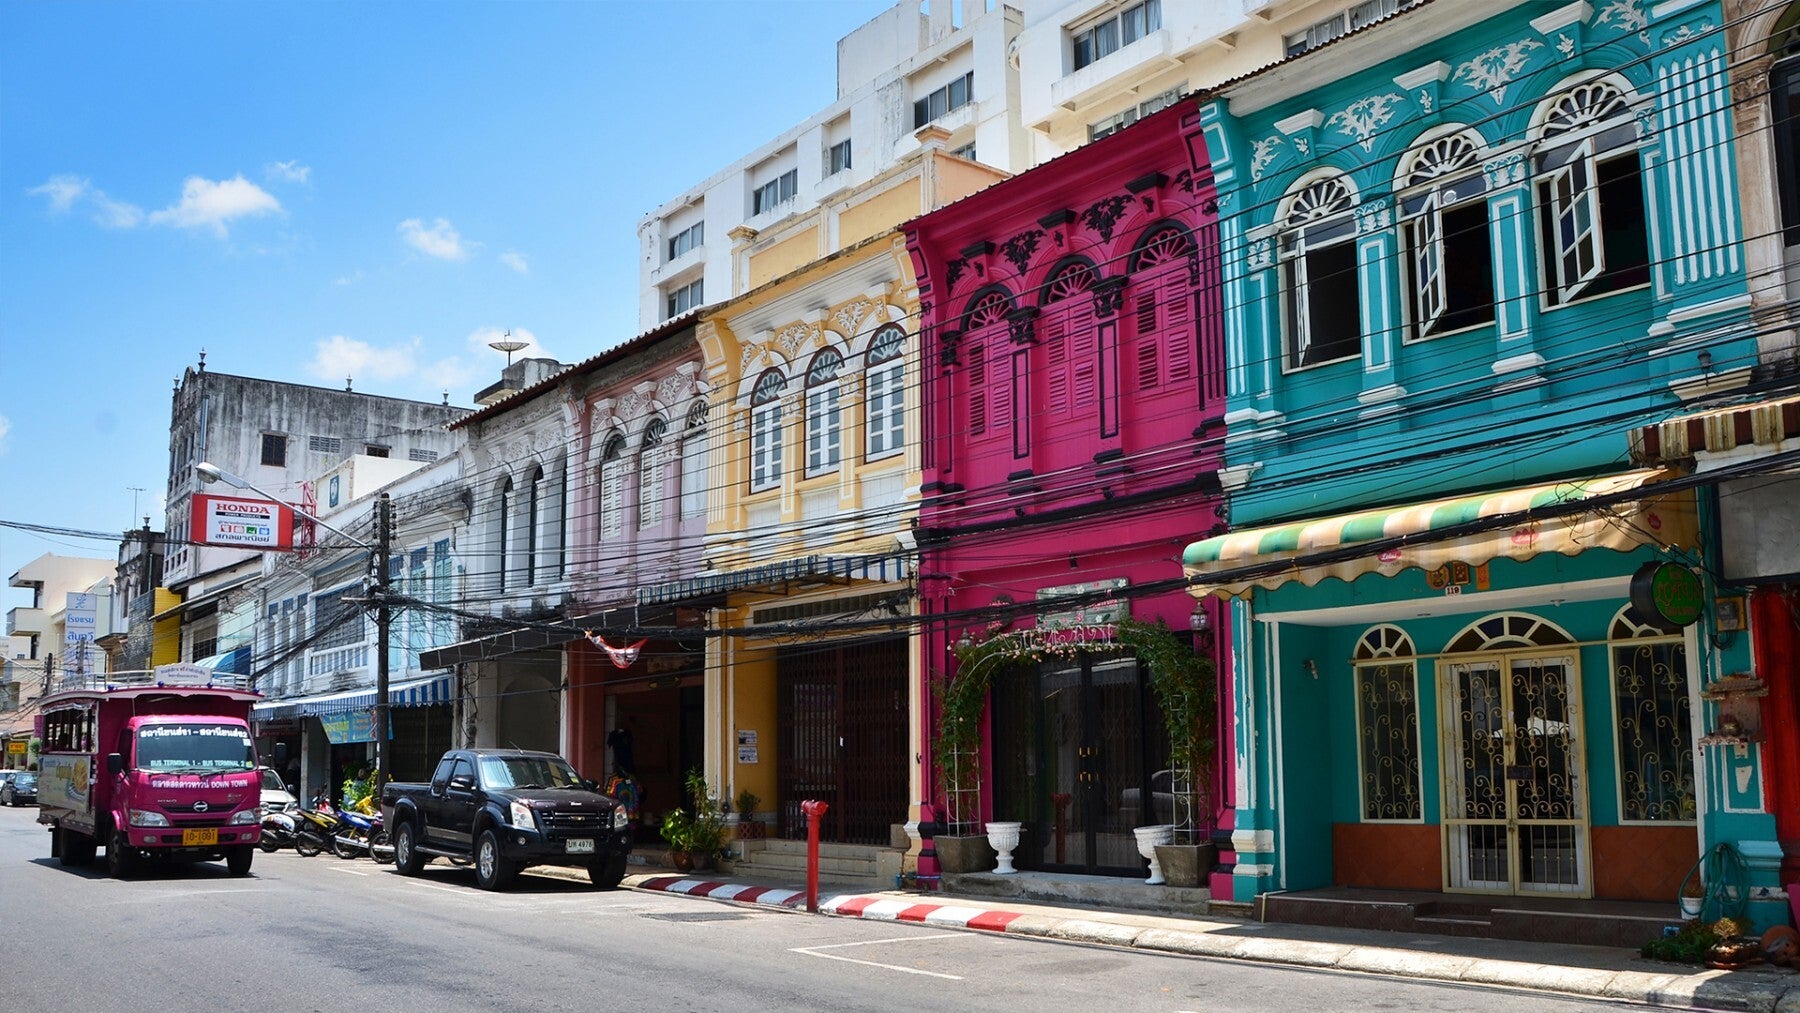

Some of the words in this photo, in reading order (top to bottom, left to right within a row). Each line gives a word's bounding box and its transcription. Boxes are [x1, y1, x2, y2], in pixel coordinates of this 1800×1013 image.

[216, 503, 270, 514] HONDA
[67, 614, 94, 623] โรงแรม
[231, 780, 248, 788] TOWN
